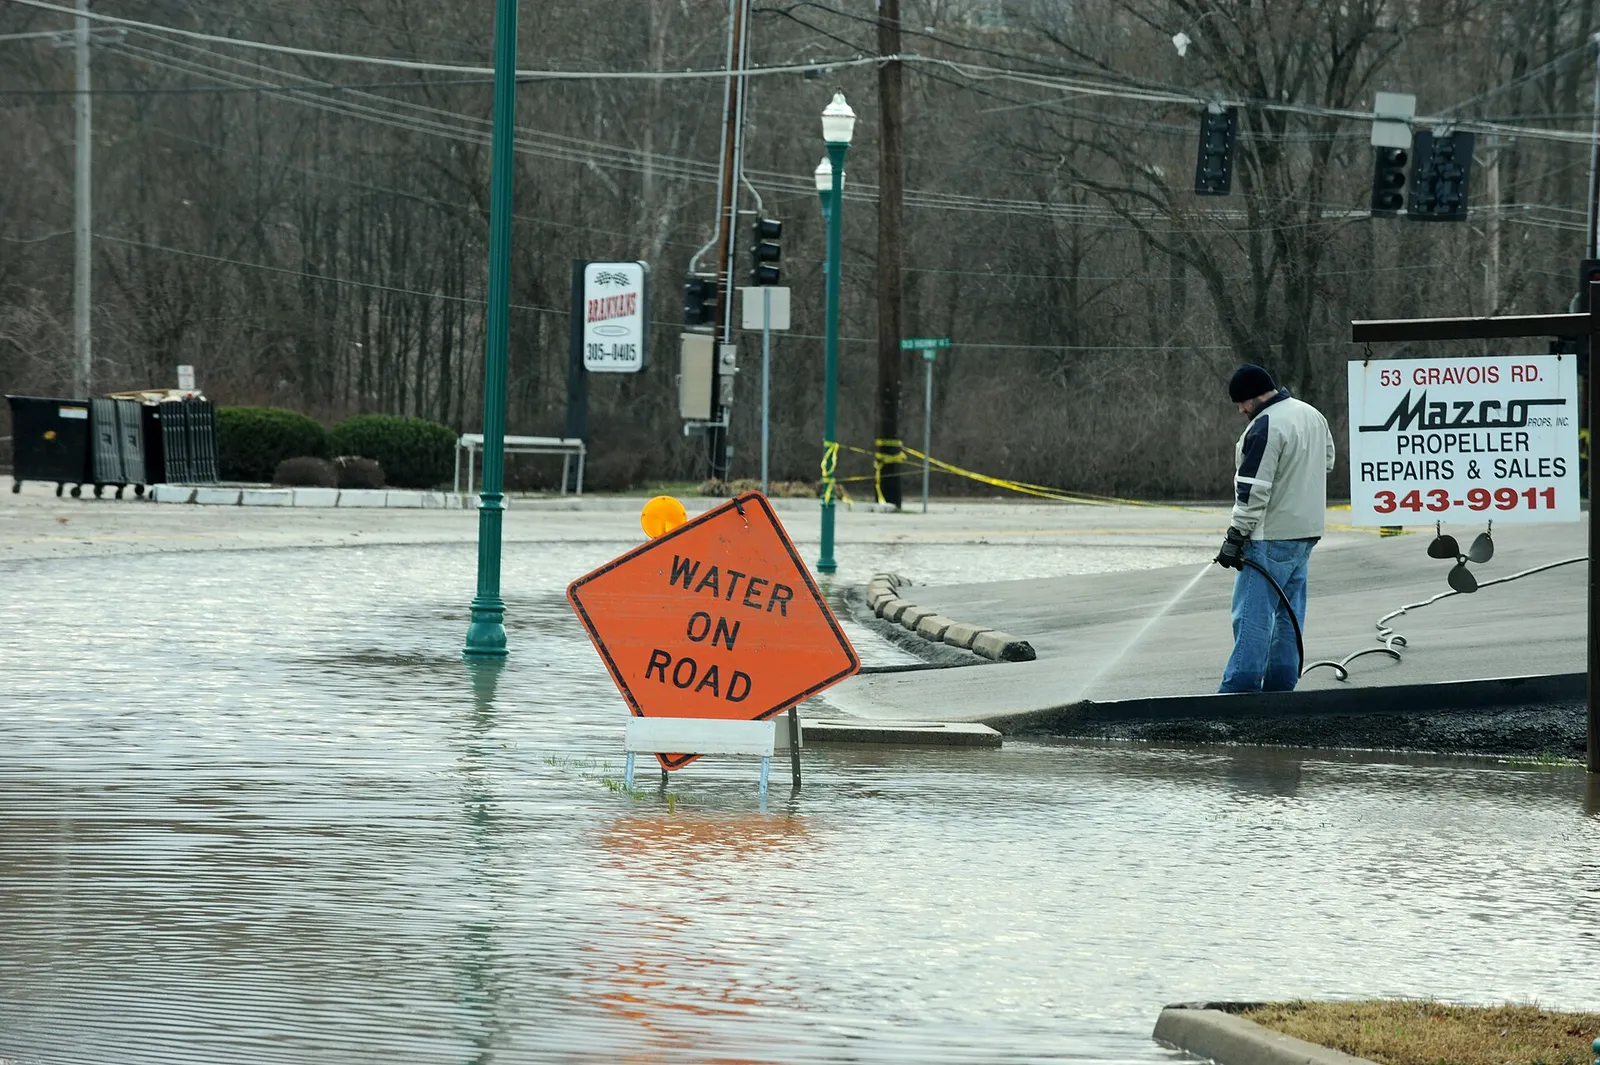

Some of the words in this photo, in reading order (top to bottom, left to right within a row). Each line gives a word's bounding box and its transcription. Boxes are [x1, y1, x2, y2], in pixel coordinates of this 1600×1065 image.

[1380, 369, 1402, 387] 53
[1412, 366, 1500, 385] GRAVOIS
[1511, 364, 1544, 383] RD.
[1397, 433, 1530, 455] PROPELLER
[1361, 459, 1455, 482] REPAIRS
[1467, 459, 1481, 480] &
[1493, 457, 1567, 479] SALES
[1373, 486, 1556, 514] 343-9911
[669, 554, 794, 617] WATER
[686, 611, 741, 651] ON
[644, 648, 752, 703] ROAD
